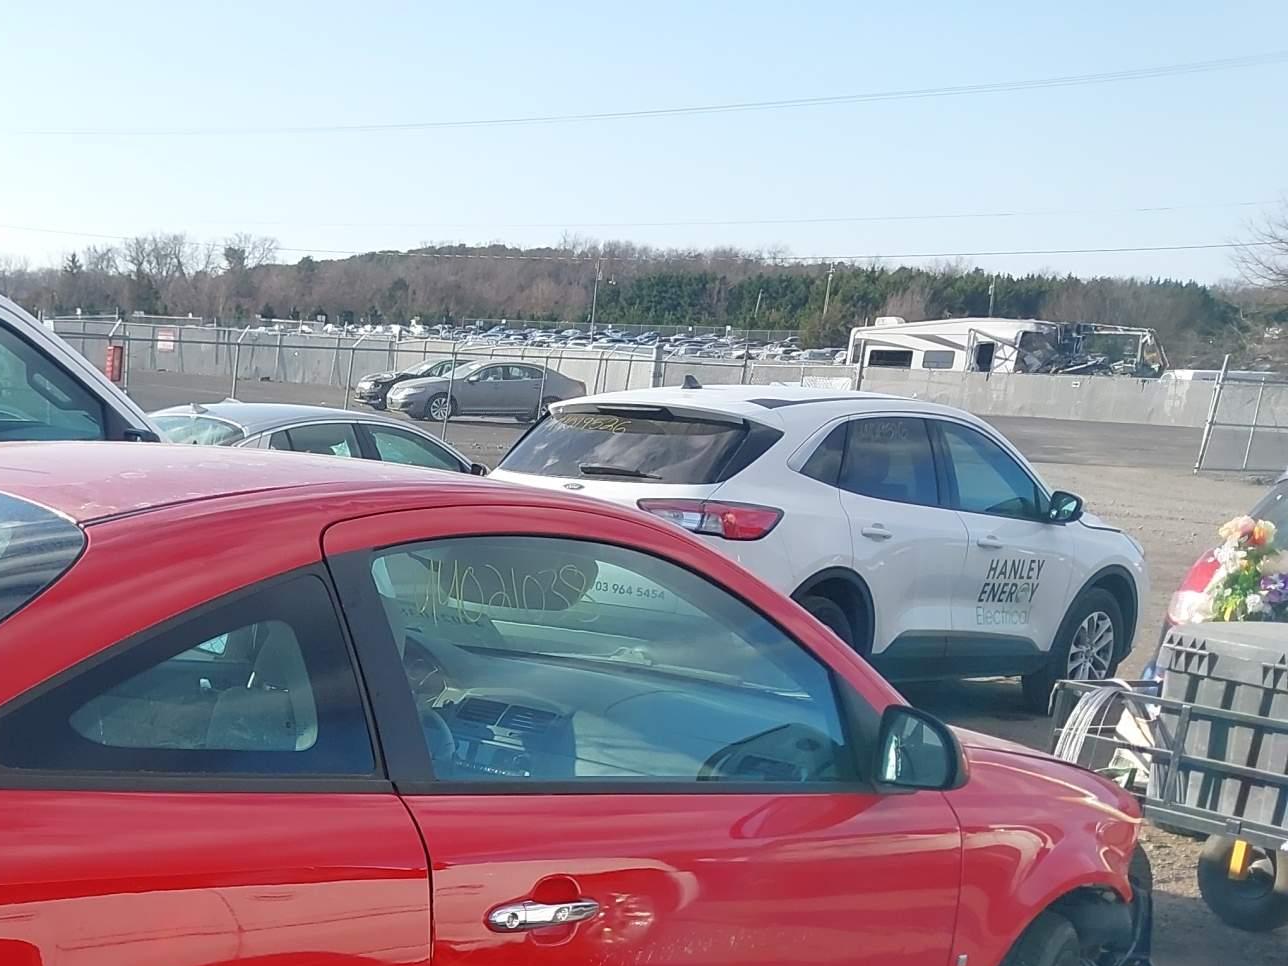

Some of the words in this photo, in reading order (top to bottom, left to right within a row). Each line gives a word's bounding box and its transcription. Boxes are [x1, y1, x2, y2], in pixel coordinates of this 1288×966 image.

[986, 559, 1045, 580] HANLEY
[592, 580, 609, 593] 03
[612, 583, 633, 596] 964
[636, 586, 665, 600] 5454
[976, 606, 1031, 625] Electrical
